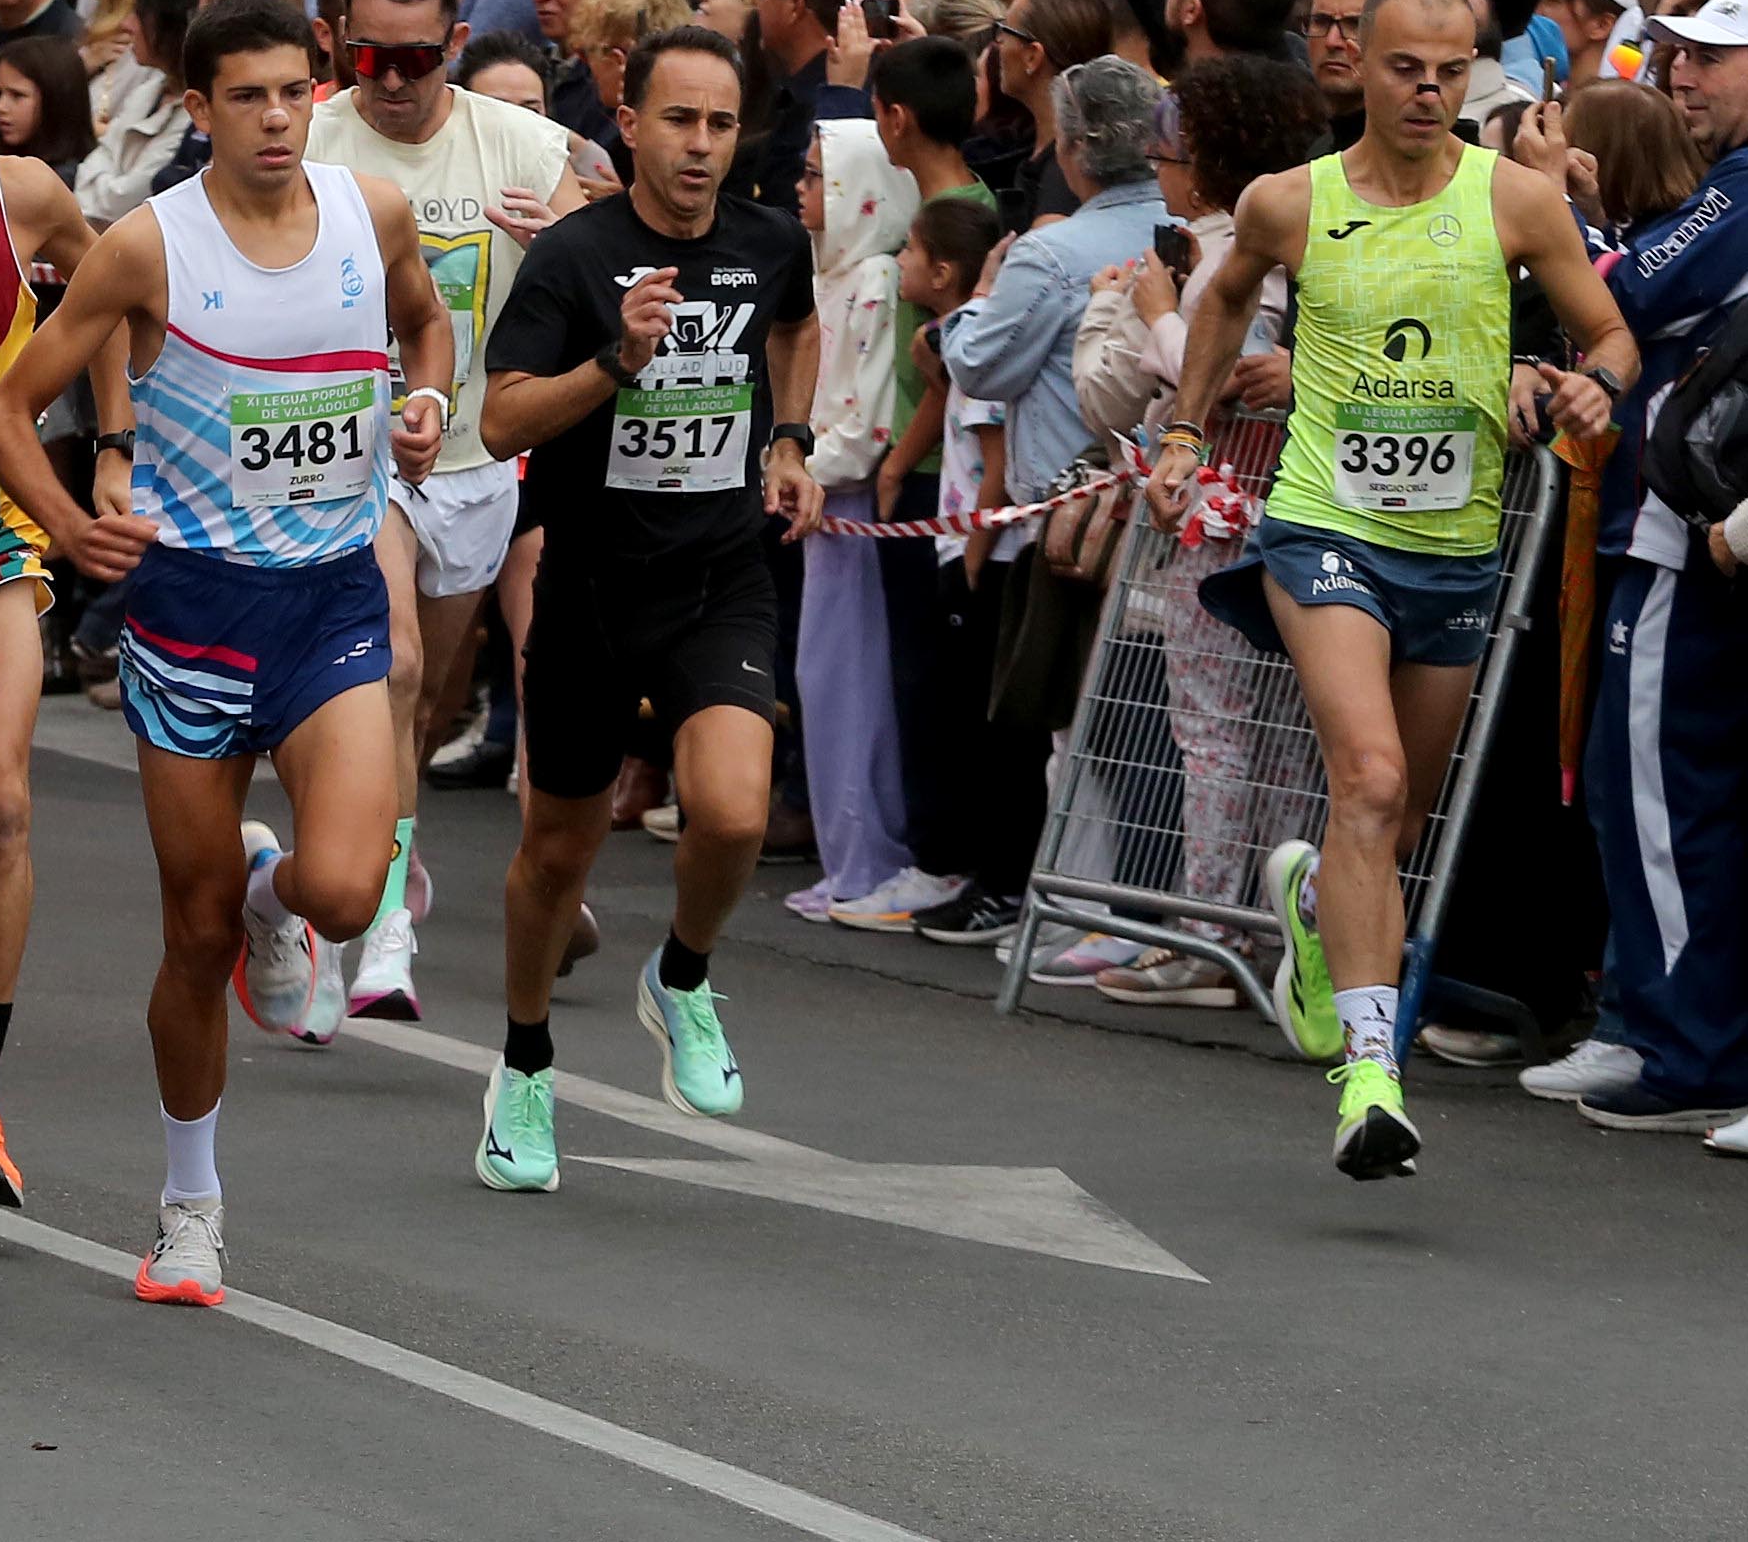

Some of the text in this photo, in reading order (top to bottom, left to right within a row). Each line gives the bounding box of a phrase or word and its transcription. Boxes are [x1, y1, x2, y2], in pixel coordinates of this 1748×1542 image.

[721, 273, 757, 288] epm
[247, 383, 365, 407] XI LEGUA POPULAR
[633, 387, 741, 403] XI LEGUA POPULAR
[1352, 372, 1455, 399] Adarsa
[261, 398, 360, 419] DE VALLADOLID
[644, 399, 733, 414] DE VALLADOLID
[240, 415, 364, 472] 3481
[618, 415, 736, 460] 3517
[1340, 433, 1456, 477] 3396
[290, 473, 325, 485] ZURRO
[662, 465, 692, 475] JORGE
